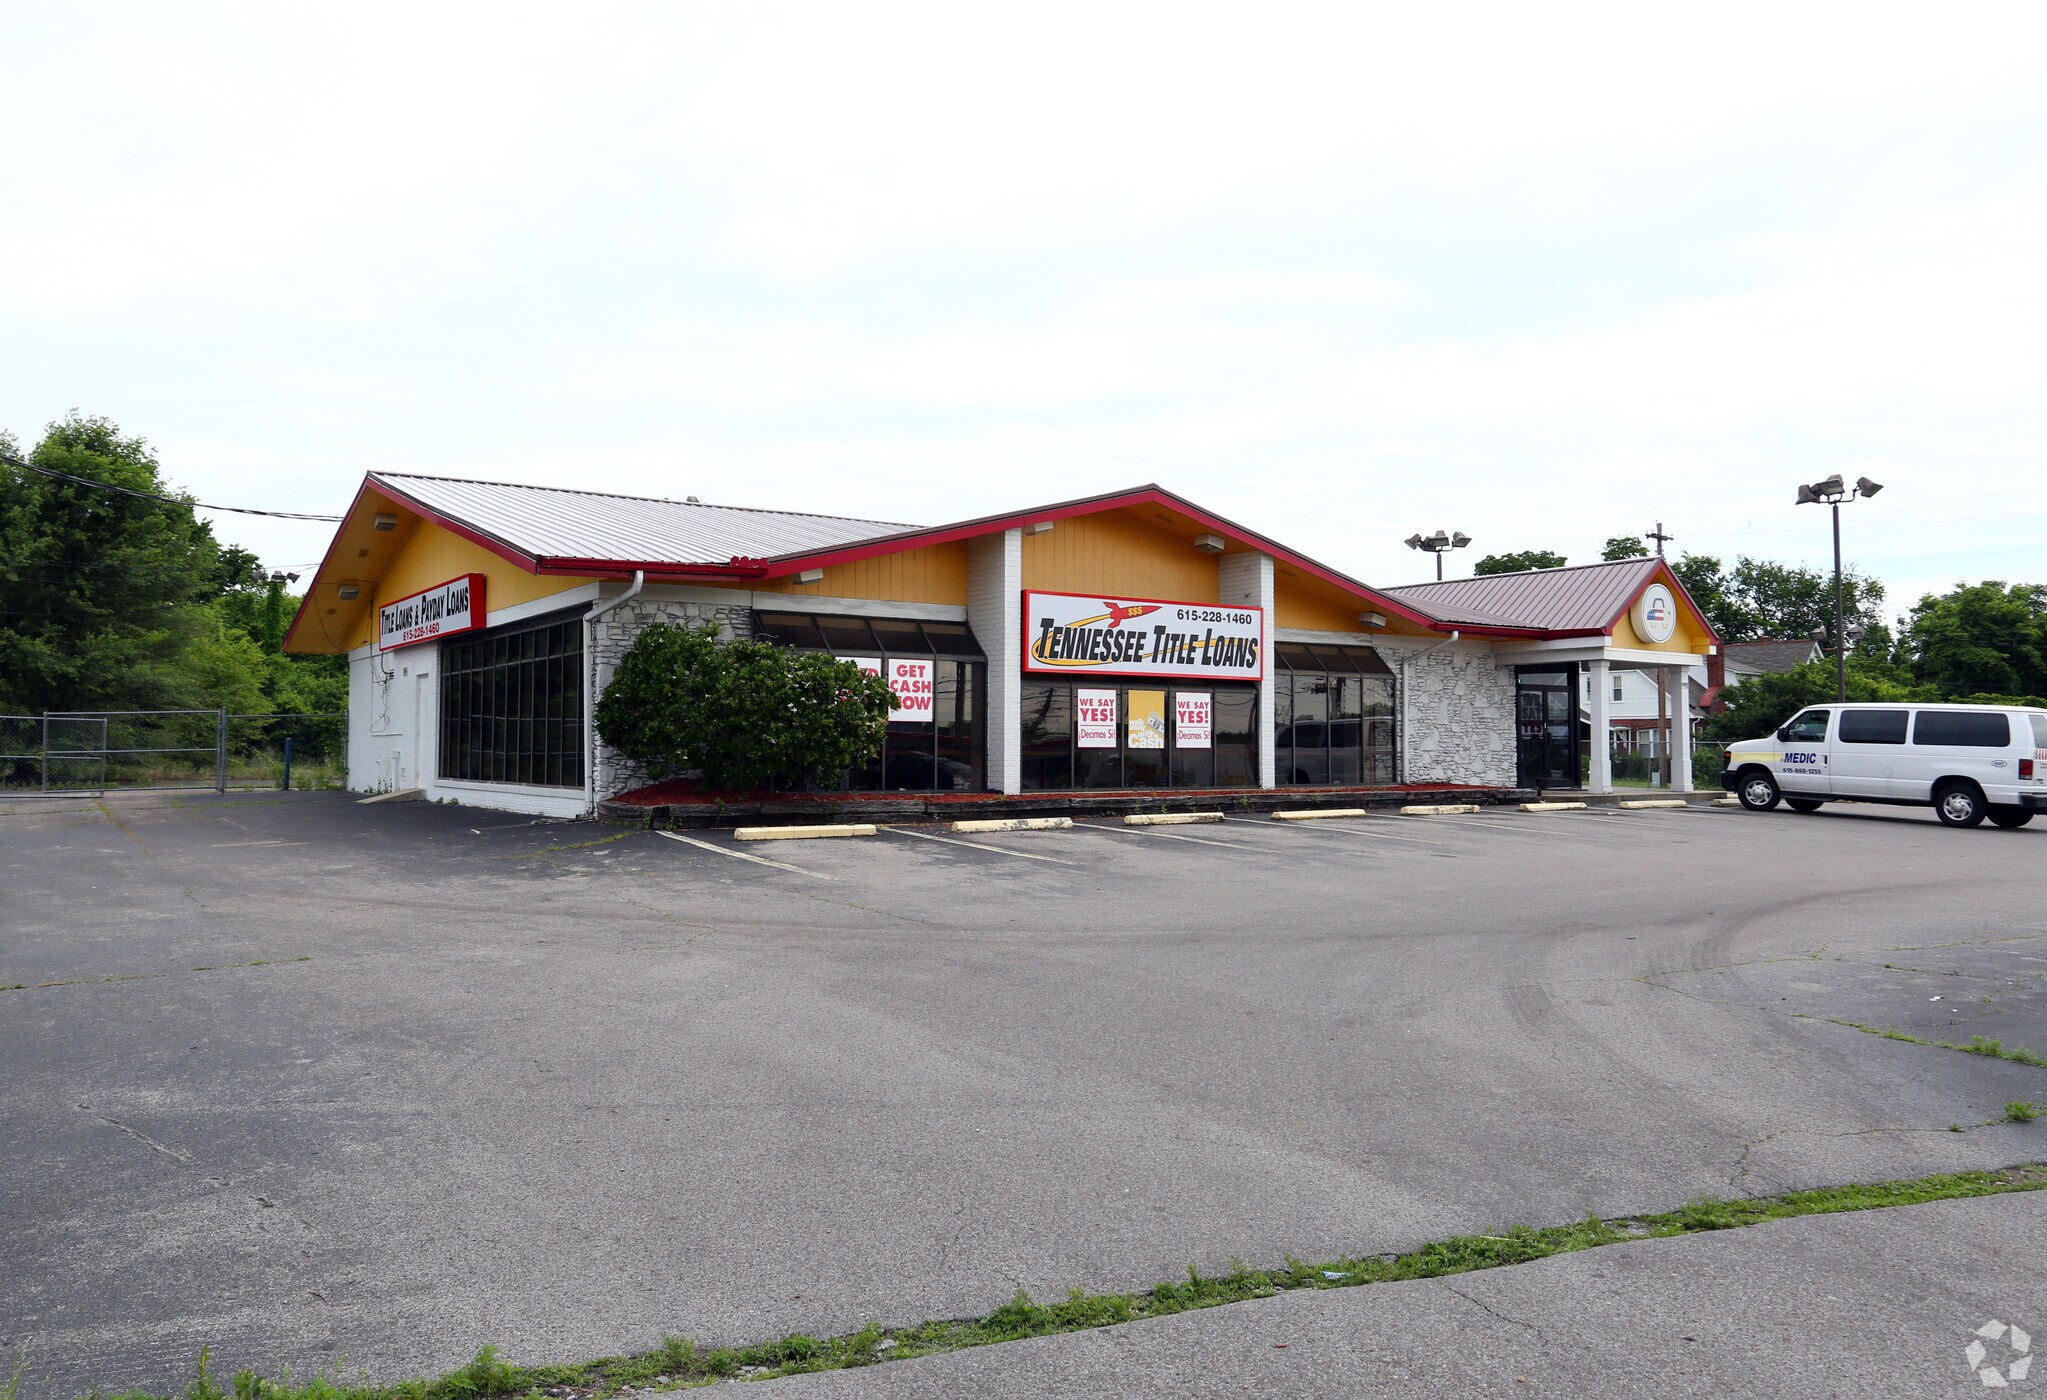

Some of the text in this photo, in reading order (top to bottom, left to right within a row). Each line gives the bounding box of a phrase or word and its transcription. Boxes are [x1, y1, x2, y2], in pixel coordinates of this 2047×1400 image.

[381, 586, 468, 635] TITLE LOANS & PAYDAY LOANS
[1177, 609, 1252, 625] 615-228-1460
[403, 622, 439, 640] 615-228-1460
[1037, 617, 1258, 669] TENNESSEE TITLE LOANS
[896, 664, 926, 678] GET
[890, 679, 931, 693] CASH
[1079, 698, 1115, 707] WE SAY
[1177, 701, 1209, 709] WE SAY
[1079, 708, 1114, 722] YES!
[1177, 710, 1209, 724] YES!
[1784, 752, 1817, 764] MEDIC
